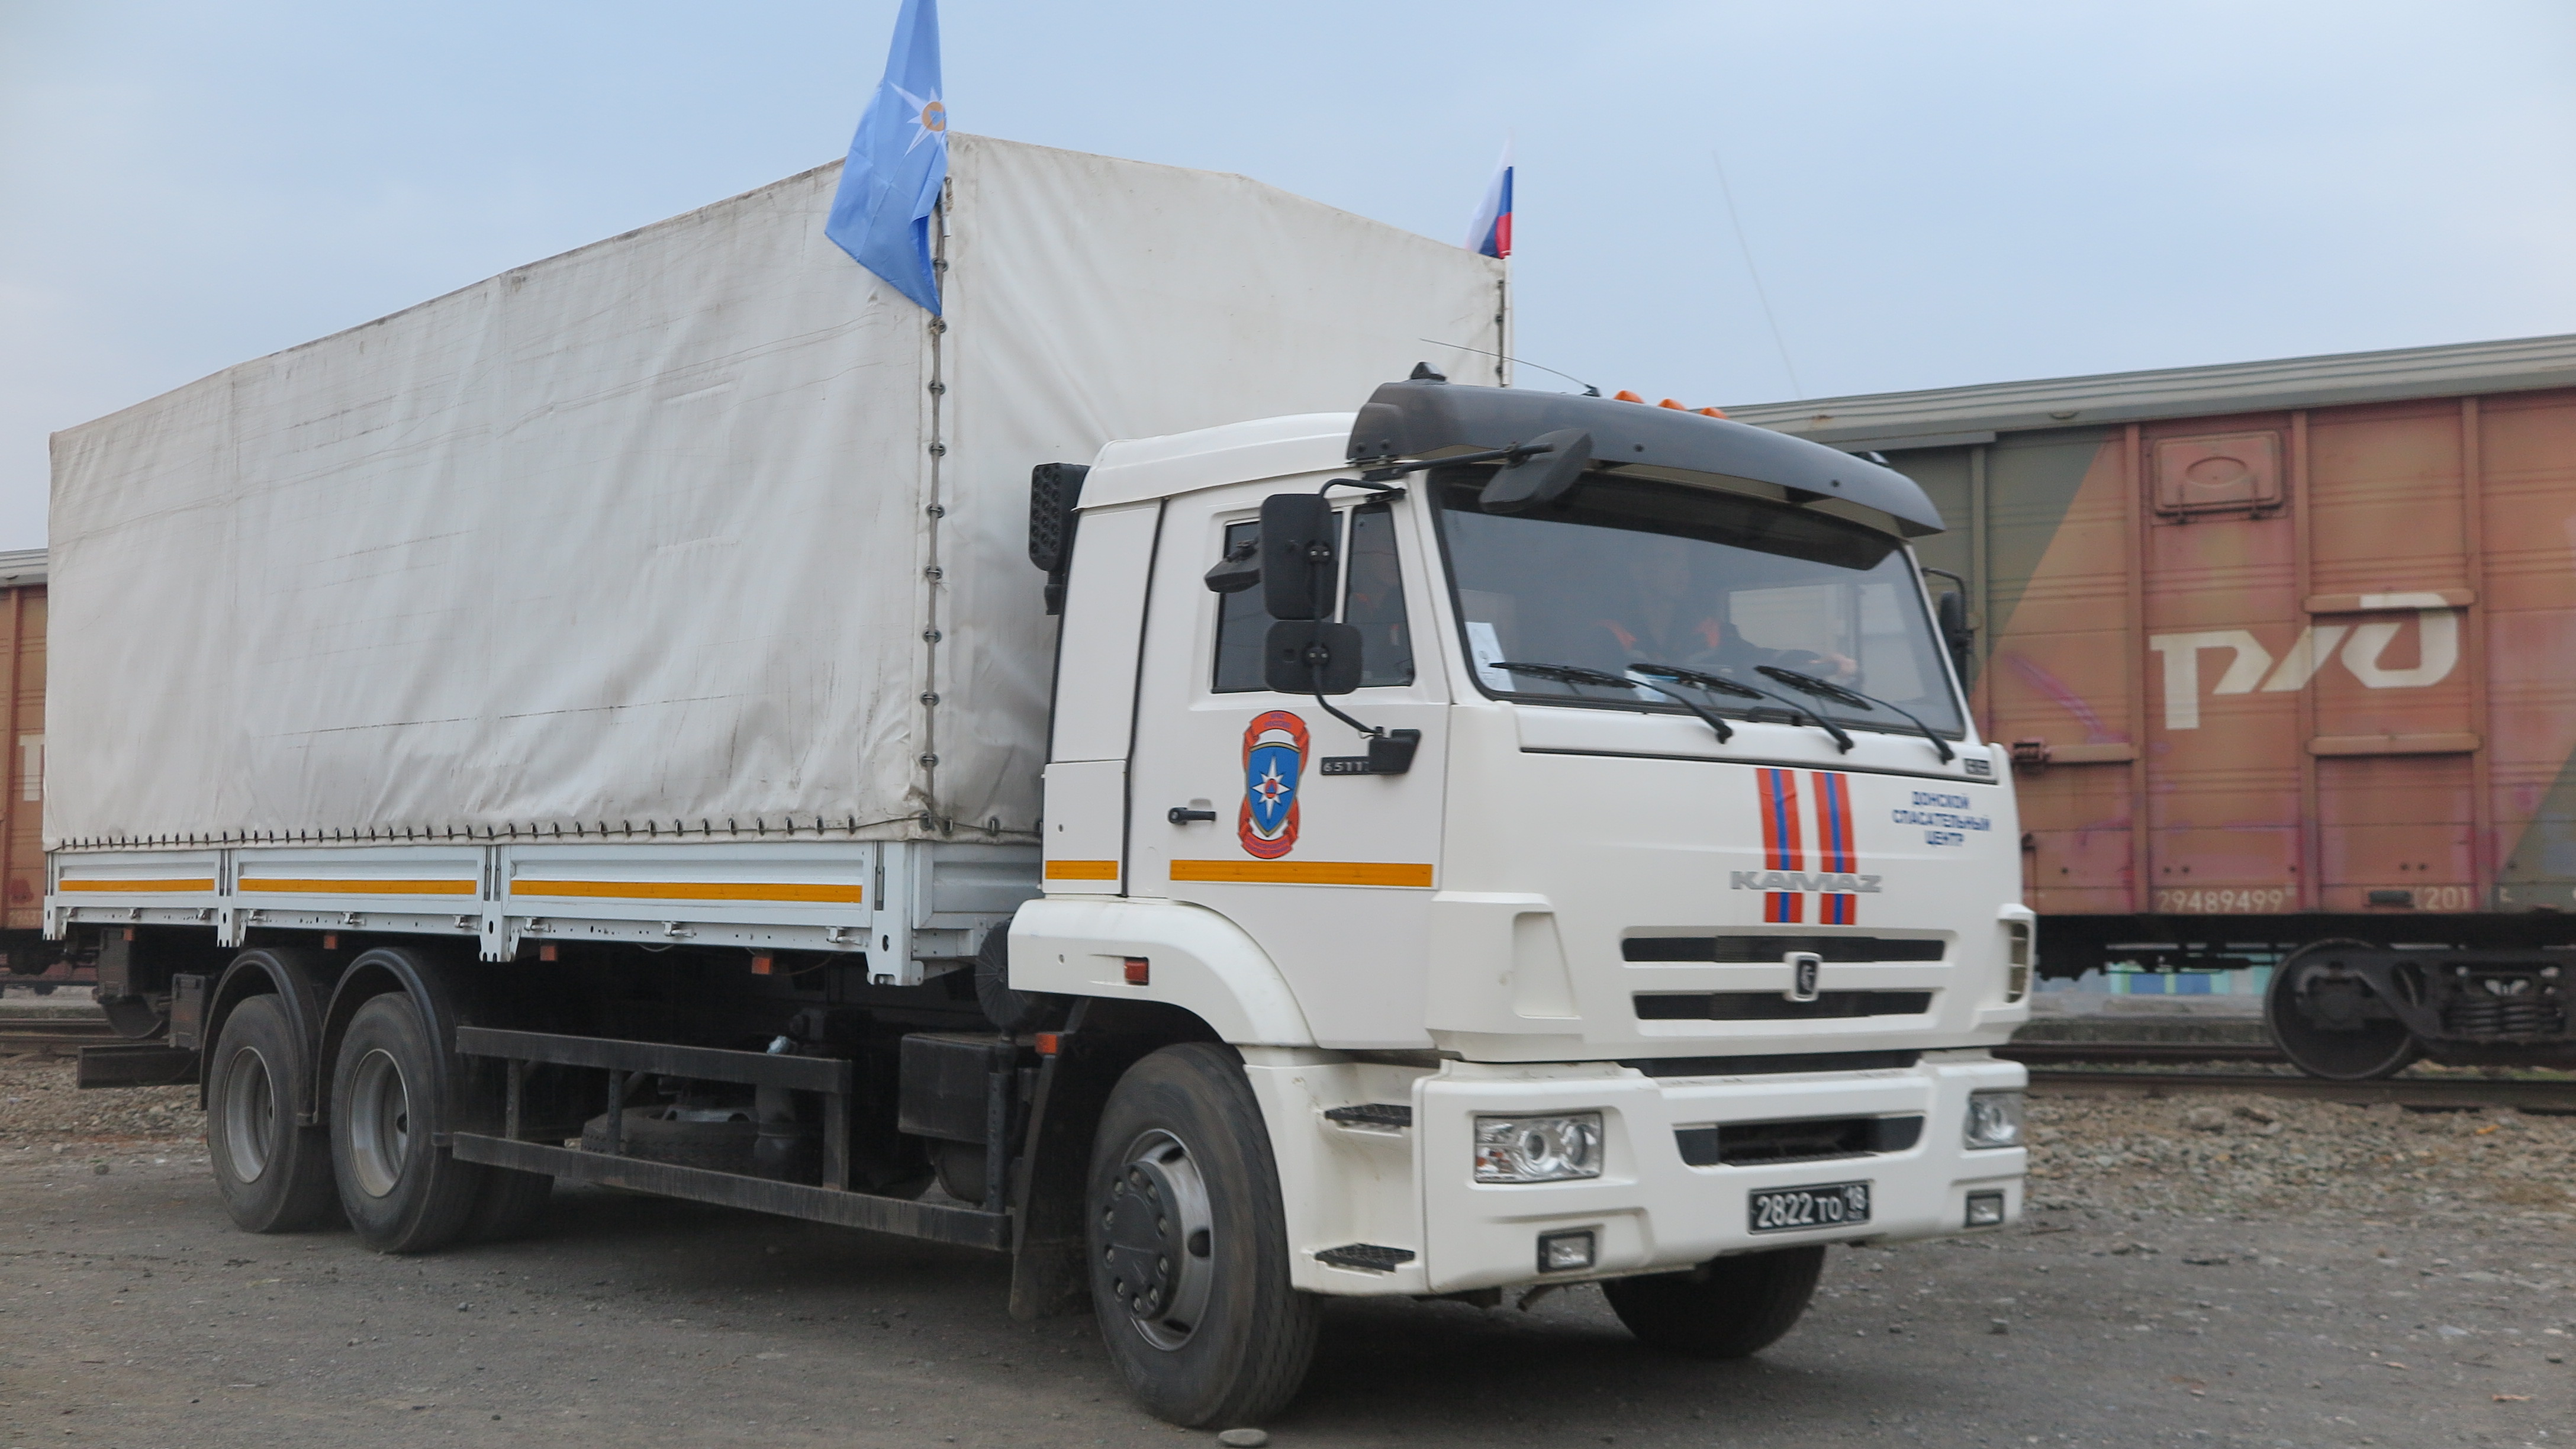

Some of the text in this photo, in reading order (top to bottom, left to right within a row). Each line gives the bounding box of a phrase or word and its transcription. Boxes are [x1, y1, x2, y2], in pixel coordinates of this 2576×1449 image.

[1912, 791, 1970, 809] ДОНСКОЙ
[1892, 809, 1991, 831] СПАСАТЕЛЬНЫЙ
[1925, 830, 1965, 847] ЦЕНТР
[1730, 871, 1882, 893] KAMAZ
[1756, 1192, 1815, 1228] 2822
